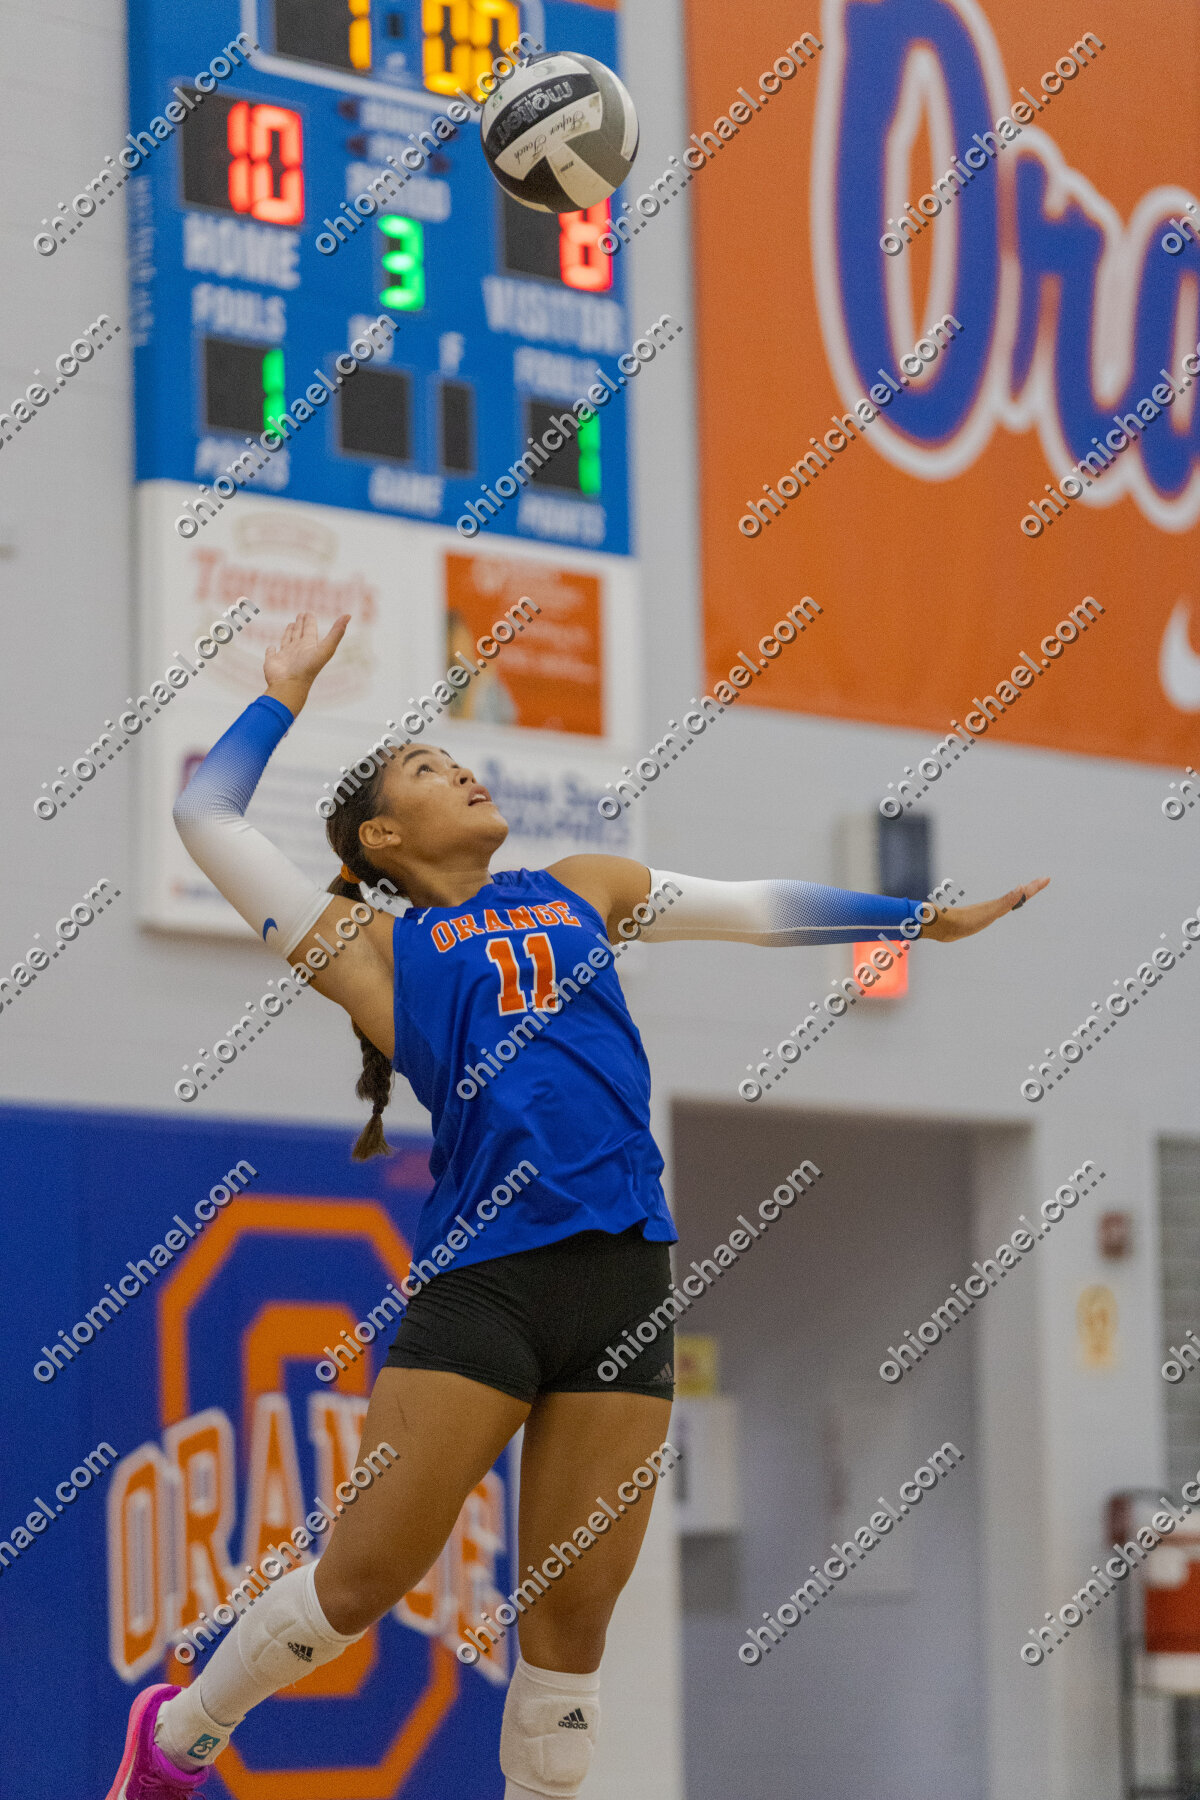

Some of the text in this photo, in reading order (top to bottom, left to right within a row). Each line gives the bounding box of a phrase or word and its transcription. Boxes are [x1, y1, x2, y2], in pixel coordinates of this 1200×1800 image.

[497, 81, 573, 144] molten
[514, 110, 584, 165] Super Touch
[228, 100, 304, 226] 10
[377, 214, 425, 312] 3
[262, 349, 287, 440] 1
[431, 900, 582, 953] ORANGE
[485, 932, 558, 1017] 11
